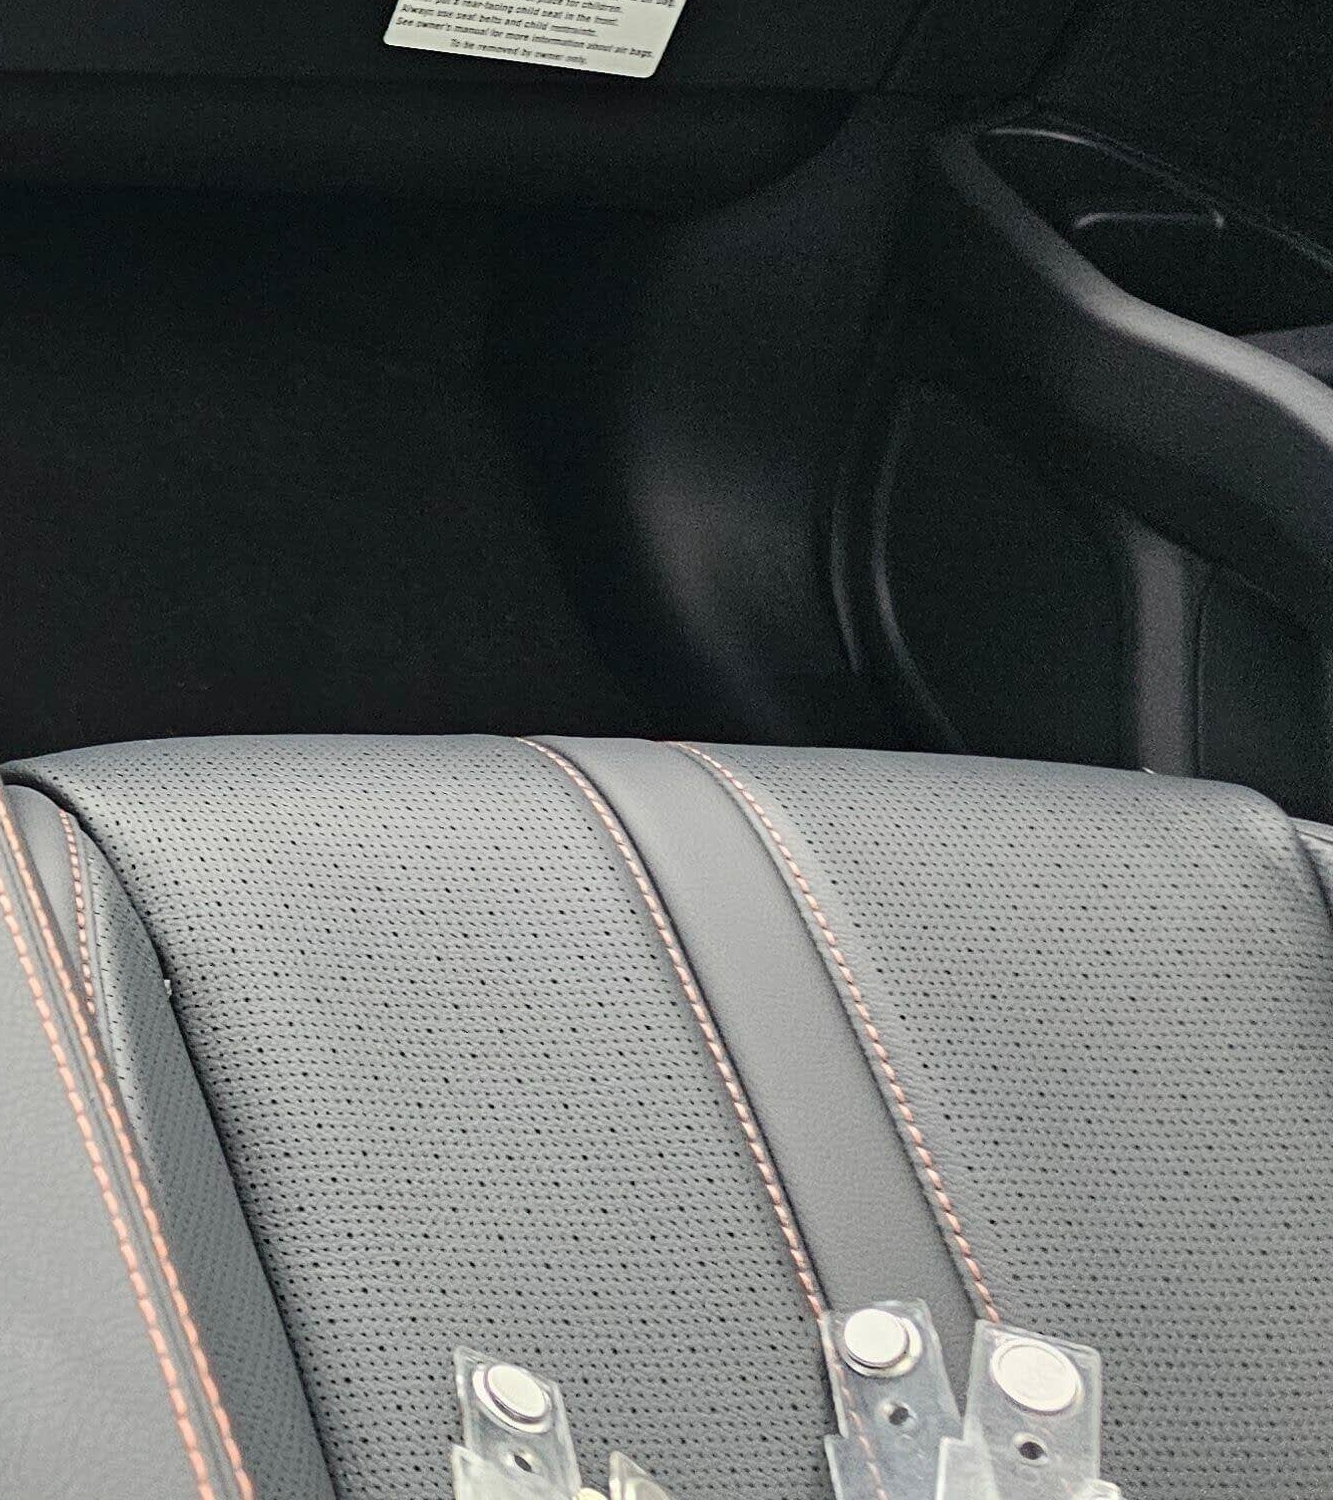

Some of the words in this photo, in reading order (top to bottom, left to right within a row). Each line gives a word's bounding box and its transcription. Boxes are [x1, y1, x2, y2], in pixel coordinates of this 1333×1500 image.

[400, 3, 436, 18] Always
[478, 14, 504, 25] belts
[504, 18, 523, 28] and
[523, 19, 549, 31] child
[515, 6, 540, 16] child
[540, 10, 564, 19] seat
[564, 12, 576, 21] in
[576, 12, 592, 22] the
[394, 16, 415, 27] See
[415, 20, 453, 32] owner's
[454, 25, 490, 36] manual
[489, 28, 504, 38] for
[505, 32, 530, 42] more
[614, 46, 629, 54] air
[476, 43, 521, 56] removed
[532, 51, 566, 62] owner
